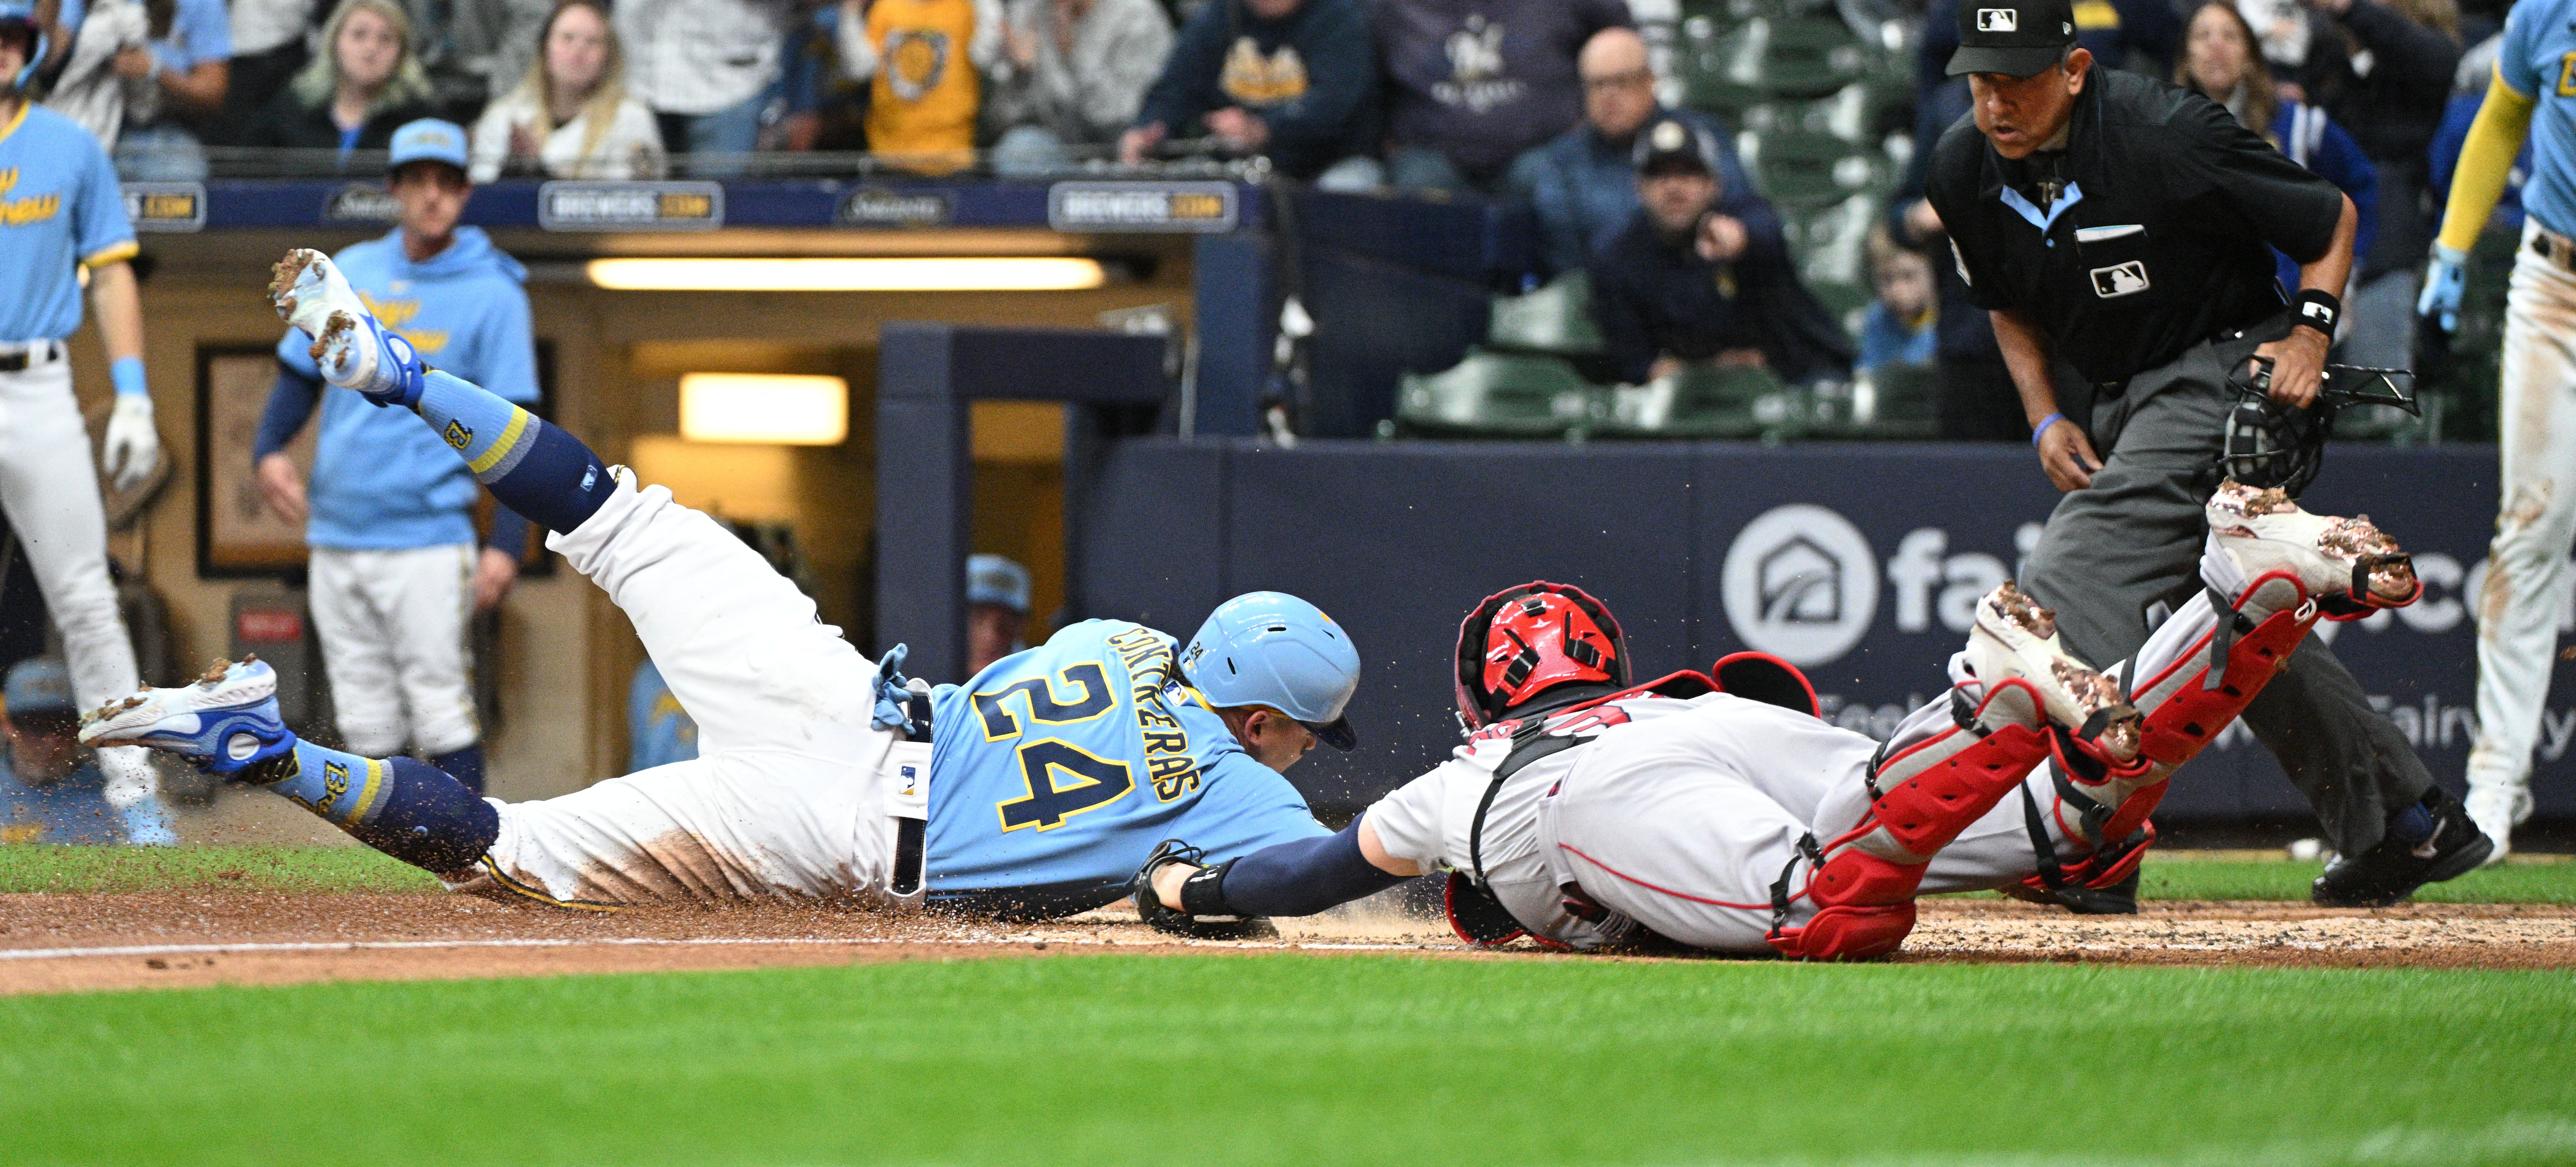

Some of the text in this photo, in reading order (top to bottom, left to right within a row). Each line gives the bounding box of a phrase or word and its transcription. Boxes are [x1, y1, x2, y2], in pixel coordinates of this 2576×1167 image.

[1105, 627, 1201, 803] CONTRERAS
[1190, 641, 1204, 660] 24
[970, 660, 1136, 833] 24
